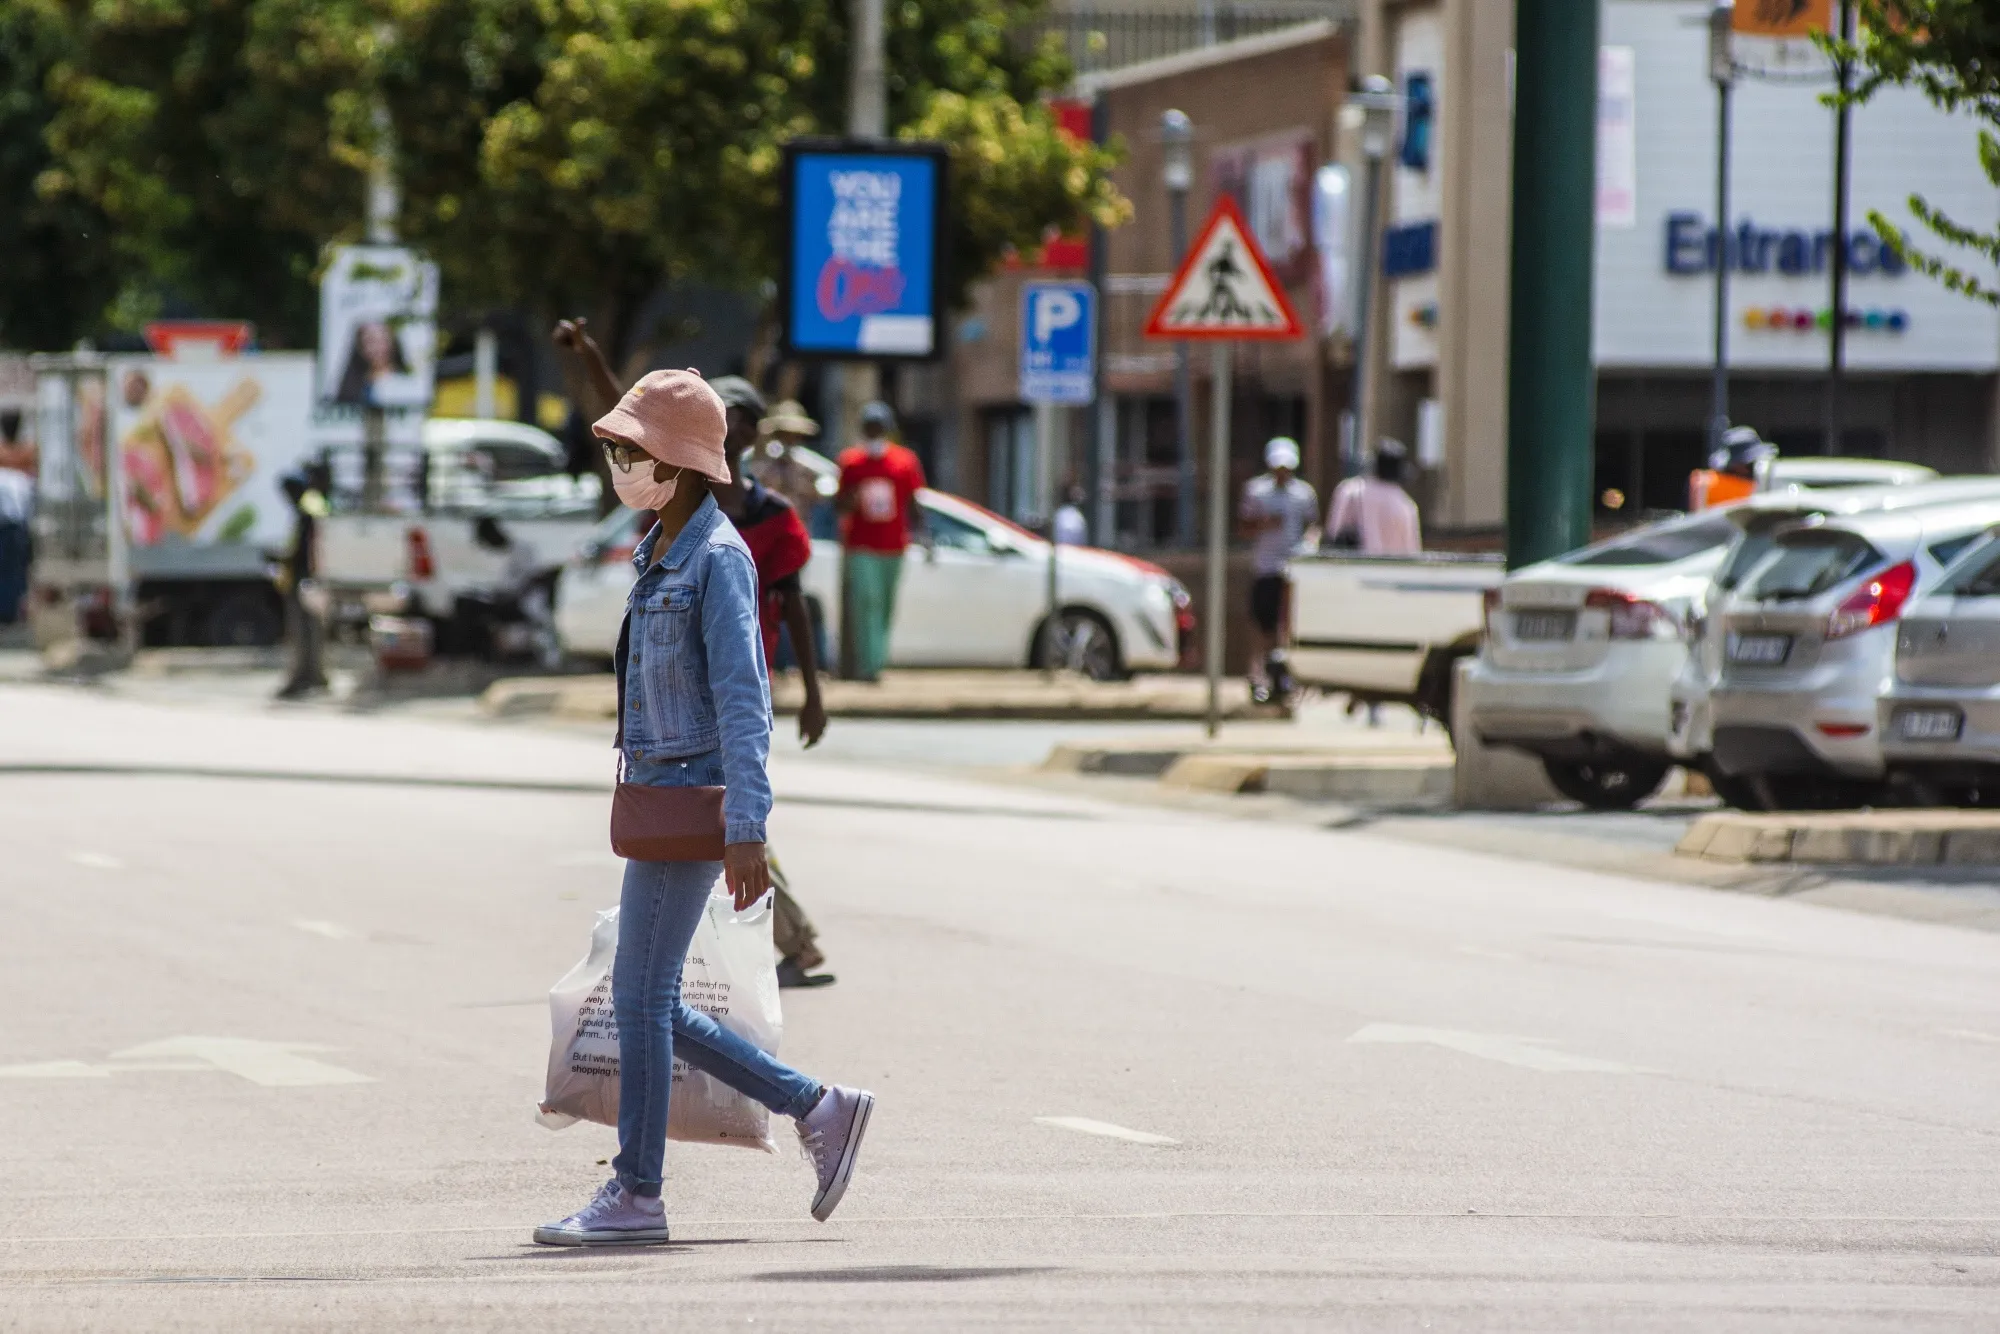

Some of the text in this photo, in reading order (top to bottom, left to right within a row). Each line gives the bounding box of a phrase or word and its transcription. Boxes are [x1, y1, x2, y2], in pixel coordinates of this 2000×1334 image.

[827, 170, 902, 198] YOU
[827, 201, 898, 229] ARE
[1034, 289, 1080, 342] P
[696, 979, 711, 989] few
[718, 983, 731, 992] my
[682, 991, 705, 1000] which
[718, 993, 728, 1002] be
[578, 1006, 596, 1017] gifts
[597, 1007, 609, 1016] for
[700, 1003, 709, 1012] to
[581, 1018, 604, 1028] could
[572, 1052, 588, 1062] But
[592, 1055, 606, 1064] will
[571, 1064, 611, 1077] shopping
